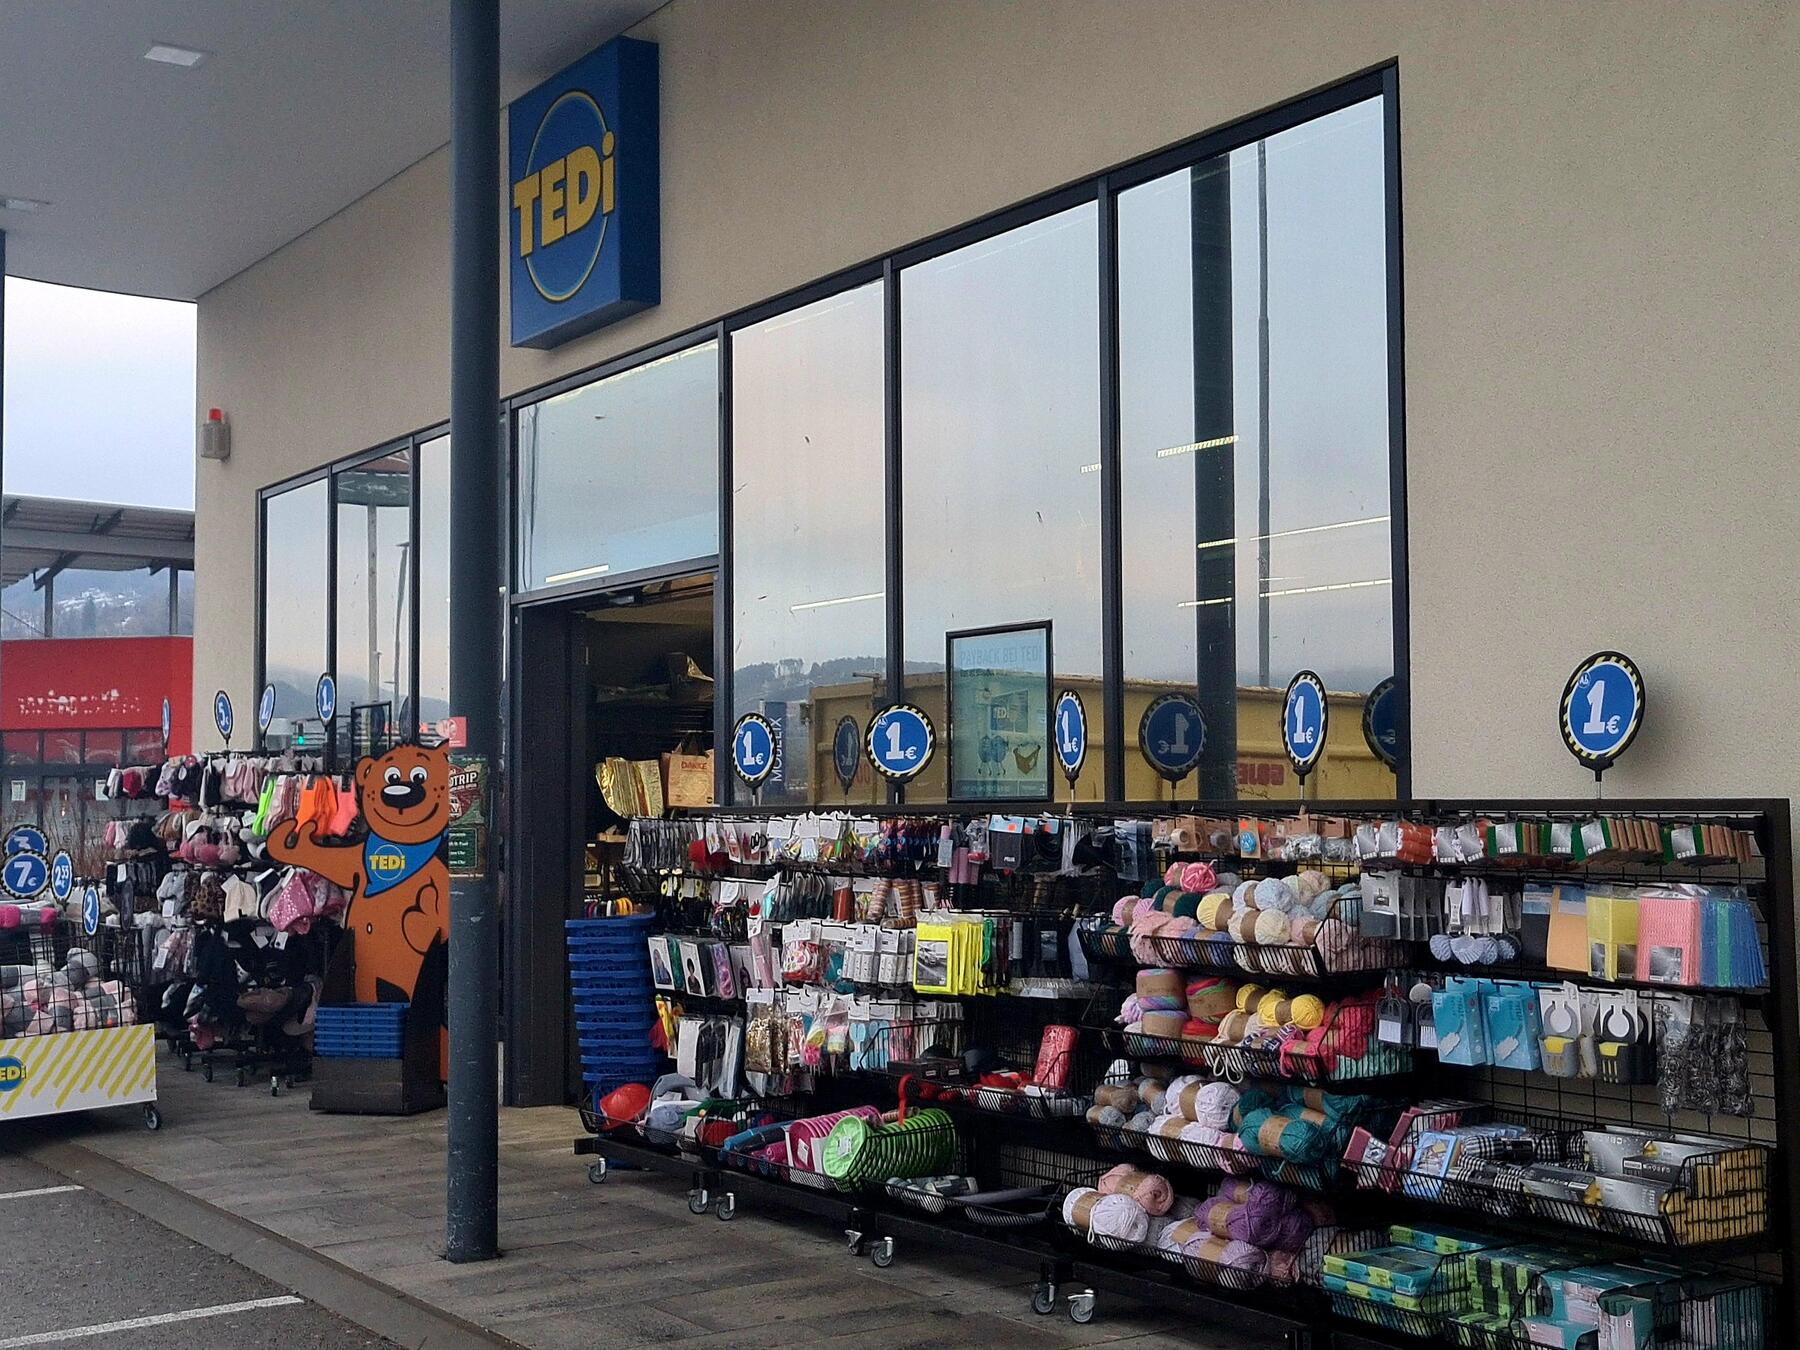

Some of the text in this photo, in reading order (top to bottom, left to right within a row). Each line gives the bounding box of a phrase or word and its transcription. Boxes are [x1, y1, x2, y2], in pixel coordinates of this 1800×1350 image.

[513, 130, 615, 258] TEDi
[1583, 680, 1621, 735] 1€
[742, 730, 764, 766] 1€
[885, 721, 917, 760] 1€
[369, 854, 406, 870] TEDi
